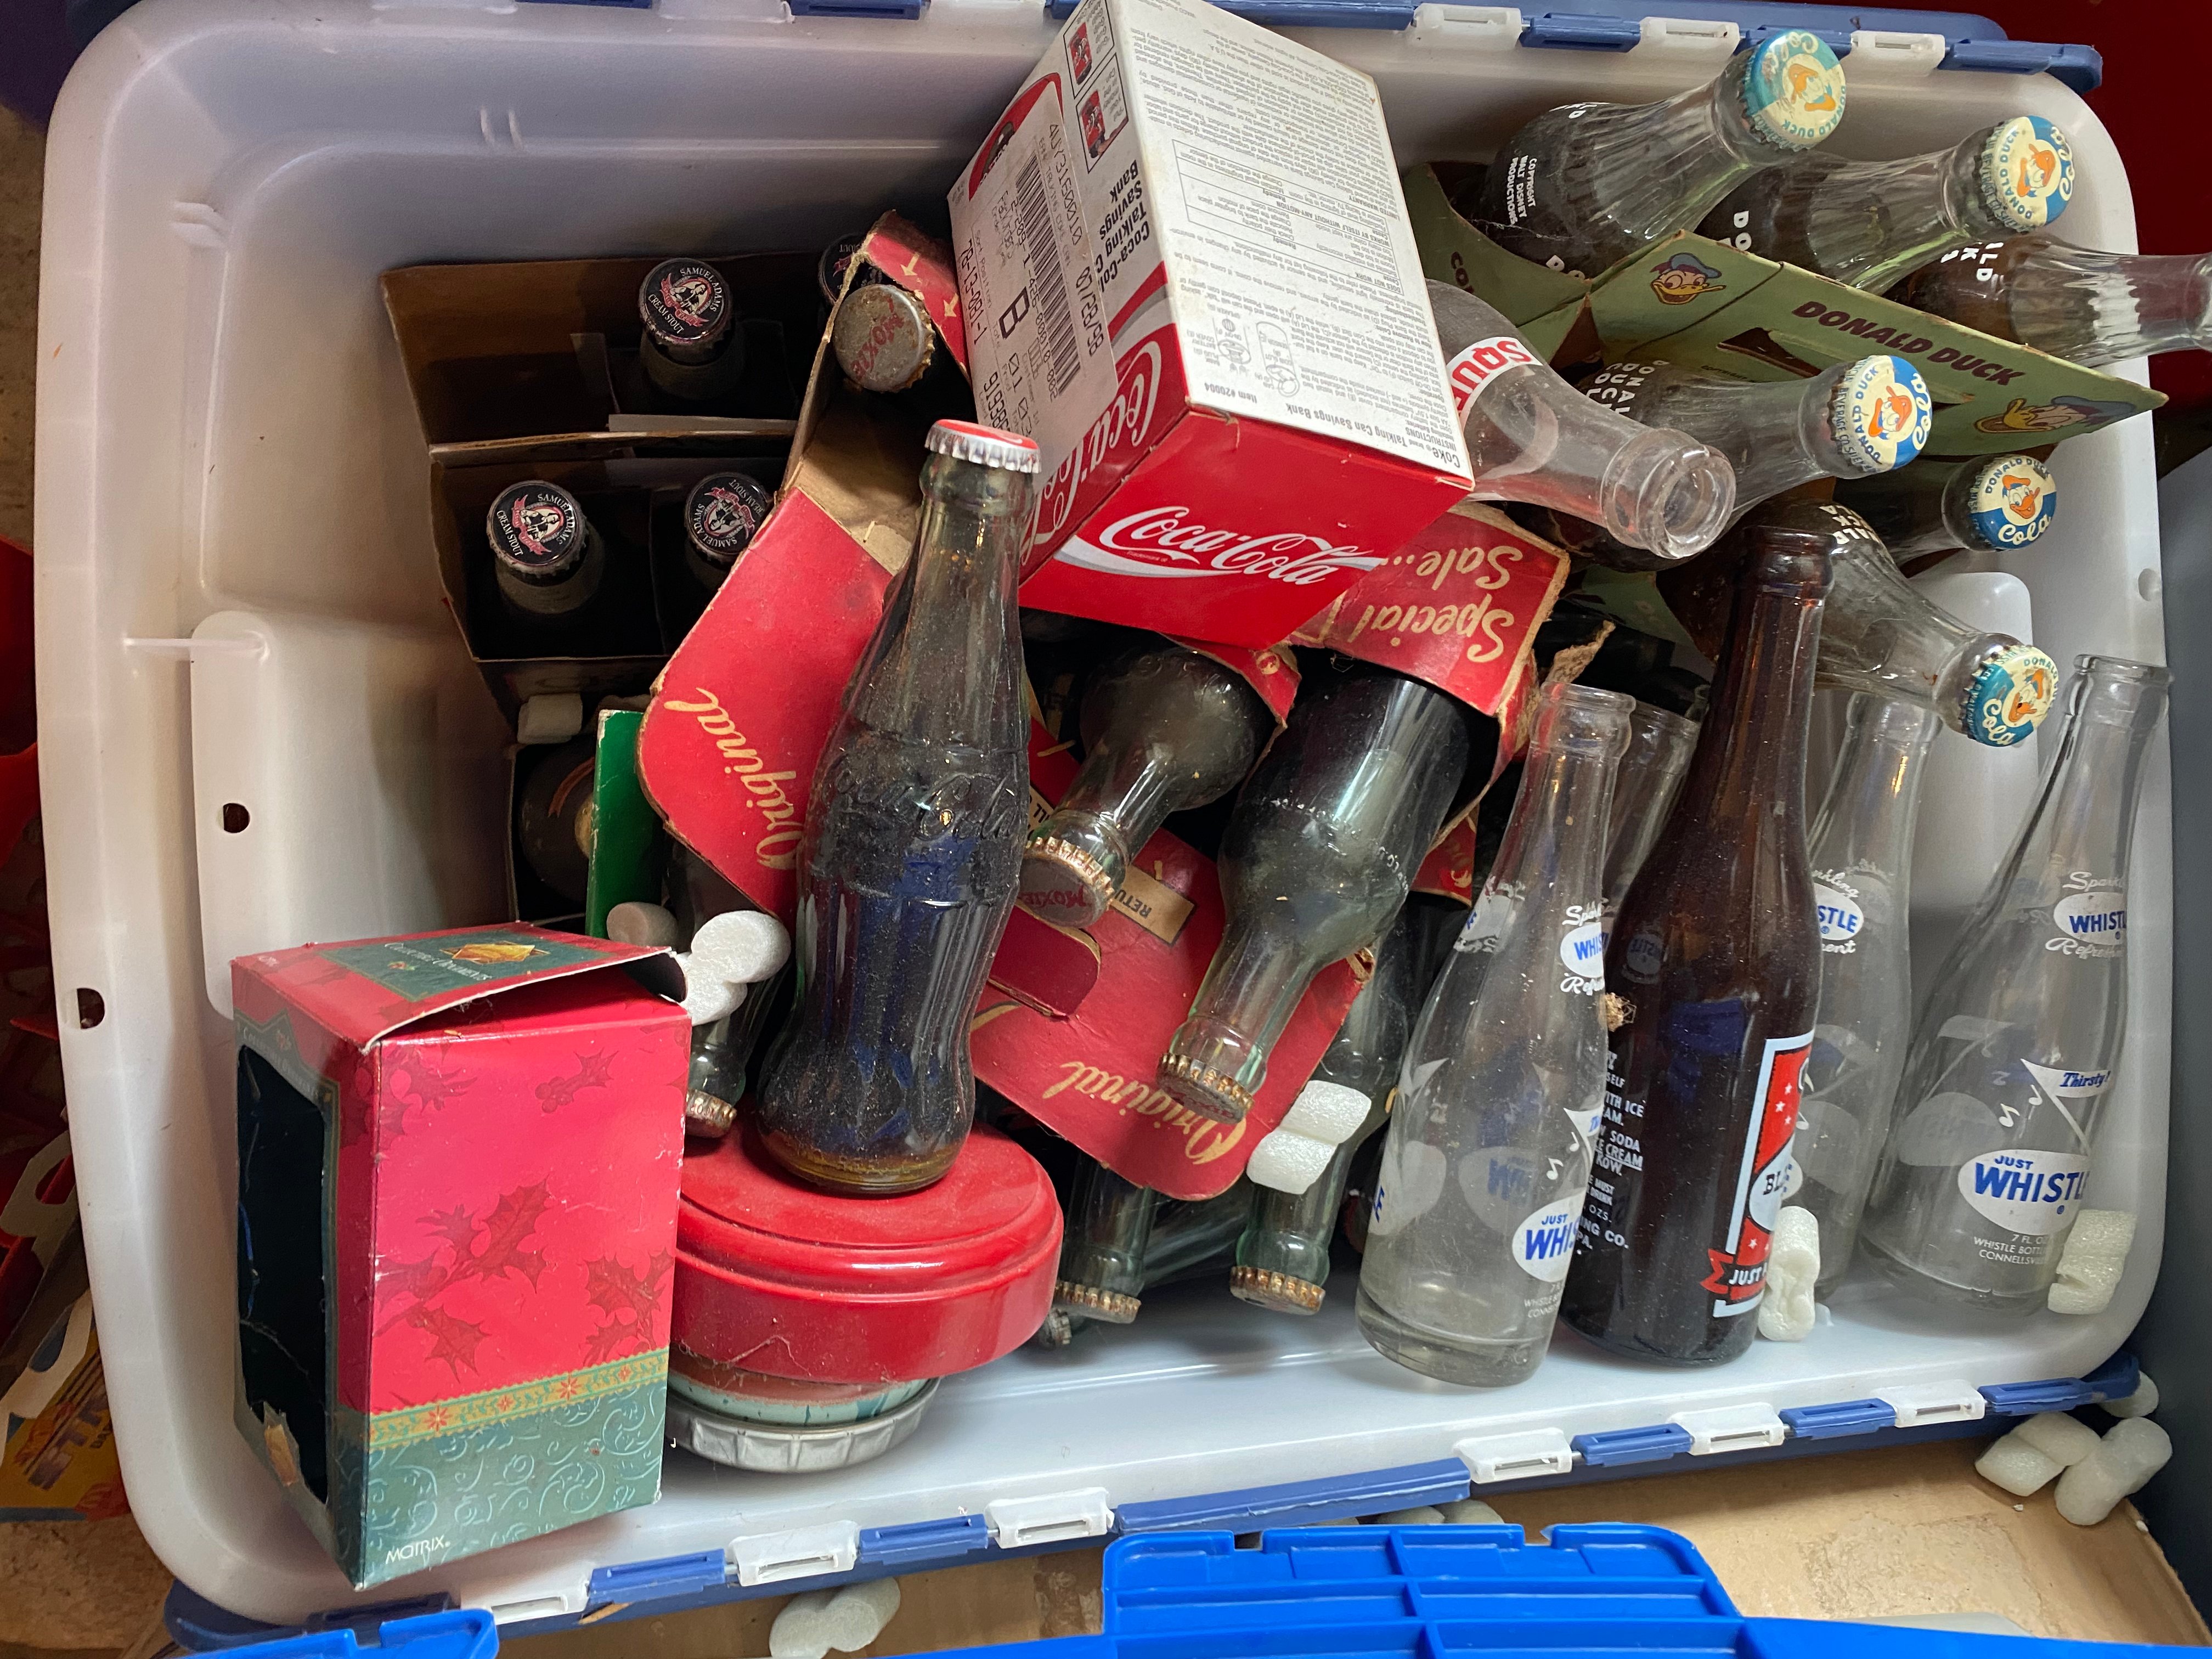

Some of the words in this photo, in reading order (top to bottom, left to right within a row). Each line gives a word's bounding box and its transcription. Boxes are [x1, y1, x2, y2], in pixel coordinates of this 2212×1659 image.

[1103, 86, 1119, 110] money
[1818, 85, 1846, 136] DONALD
[1782, 119, 1815, 138] DUCK
[1999, 131, 2019, 163] DUCK
[2050, 126, 2075, 201] Cola
[1109, 159, 1138, 204] Bank
[1506, 157, 1519, 225] PRODUCTIONS
[1999, 168, 2034, 219] DONALD
[1262, 188, 1286, 202] Remedy
[1348, 194, 1379, 213] WARRANTY
[1516, 182, 1527, 217] DISNEY
[1099, 180, 1142, 240] Savings
[1314, 213, 1340, 229] WITHOUT
[1379, 206, 1400, 221] LIMITED
[1105, 201, 1146, 257] Talking
[1341, 223, 1360, 236] ITSELF
[1361, 230, 1369, 239] BY
[1369, 234, 1390, 247] WORKS
[1372, 229, 1387, 240] Cause
[1272, 235, 1296, 250] Remedy
[974, 229, 983, 255] Sort
[979, 256, 992, 309] Position
[1355, 272, 1373, 283] WORK
[1383, 274, 1399, 285] Cause
[680, 267, 715, 283] SAMUEL
[711, 282, 724, 313] ADAMS
[961, 238, 987, 345] 78-13-081-1
[1373, 278, 1385, 287] NOT
[1385, 282, 1401, 293] DOES
[647, 294, 669, 317] CREAM
[664, 314, 685, 334] STOUT
[998, 286, 1030, 340] B
[1075, 263, 1104, 359] 07/28/98
[1791, 301, 1933, 354] DONALD
[1927, 347, 2025, 386] DUCK
[1008, 352, 1023, 394] 01
[1855, 365, 1879, 400] DUCK
[1203, 379, 1237, 400] #20004
[1237, 389, 1257, 404] Item
[1284, 400, 1312, 421] Bank
[1312, 407, 1353, 431] Savings
[1835, 387, 1849, 432] BEVERAGE
[1911, 373, 1933, 450] Cola
[1353, 420, 1373, 436] Can
[1373, 425, 1407, 447] Talking
[1404, 426, 1457, 452] INSTRUCTIONS
[1852, 405, 1882, 462] DONALD
[1431, 446, 1461, 469] Coke
[1985, 458, 2023, 494] DONALD
[728, 479, 748, 499] STOUT
[744, 496, 765, 515] REAM
[537, 494, 573, 516] SAMUEL
[556, 515, 575, 545] ADAMS
[693, 503, 706, 535] ADAMS
[1997, 514, 2052, 545] Cola
[496, 510, 514, 535] CREAM
[506, 533, 524, 556] STOUT
[702, 533, 738, 548] SAMUEL
[1099, 506, 1374, 585] Coca-Cola
[1347, 593, 1515, 663] Special
[2023, 656, 2058, 680] DONALD
[1982, 698, 2016, 746] Cola
[663, 687, 805, 870] Original
[1818, 905, 1858, 934] STLE
[2059, 1070, 2111, 1088] Thirsty!
[1042, 1061, 1247, 1165] Original
[1625, 1099, 1645, 1117] ICE
[1610, 1130, 1640, 1153] SODA
[1605, 1142, 1643, 1169] CREAM
[1994, 1155, 2034, 1171] JUST
[1595, 1180, 1615, 1195] MUST
[1974, 1161, 2090, 1203] WHISTL
[1542, 1214, 1568, 1226] JUST
[1589, 1204, 1612, 1223] OZS.
[1605, 1229, 1630, 1249] CO.
[1973, 1236, 2016, 1254] WHISTLE
[2010, 1234, 2020, 1243] 7
[1729, 1268, 1763, 1286] JUST
